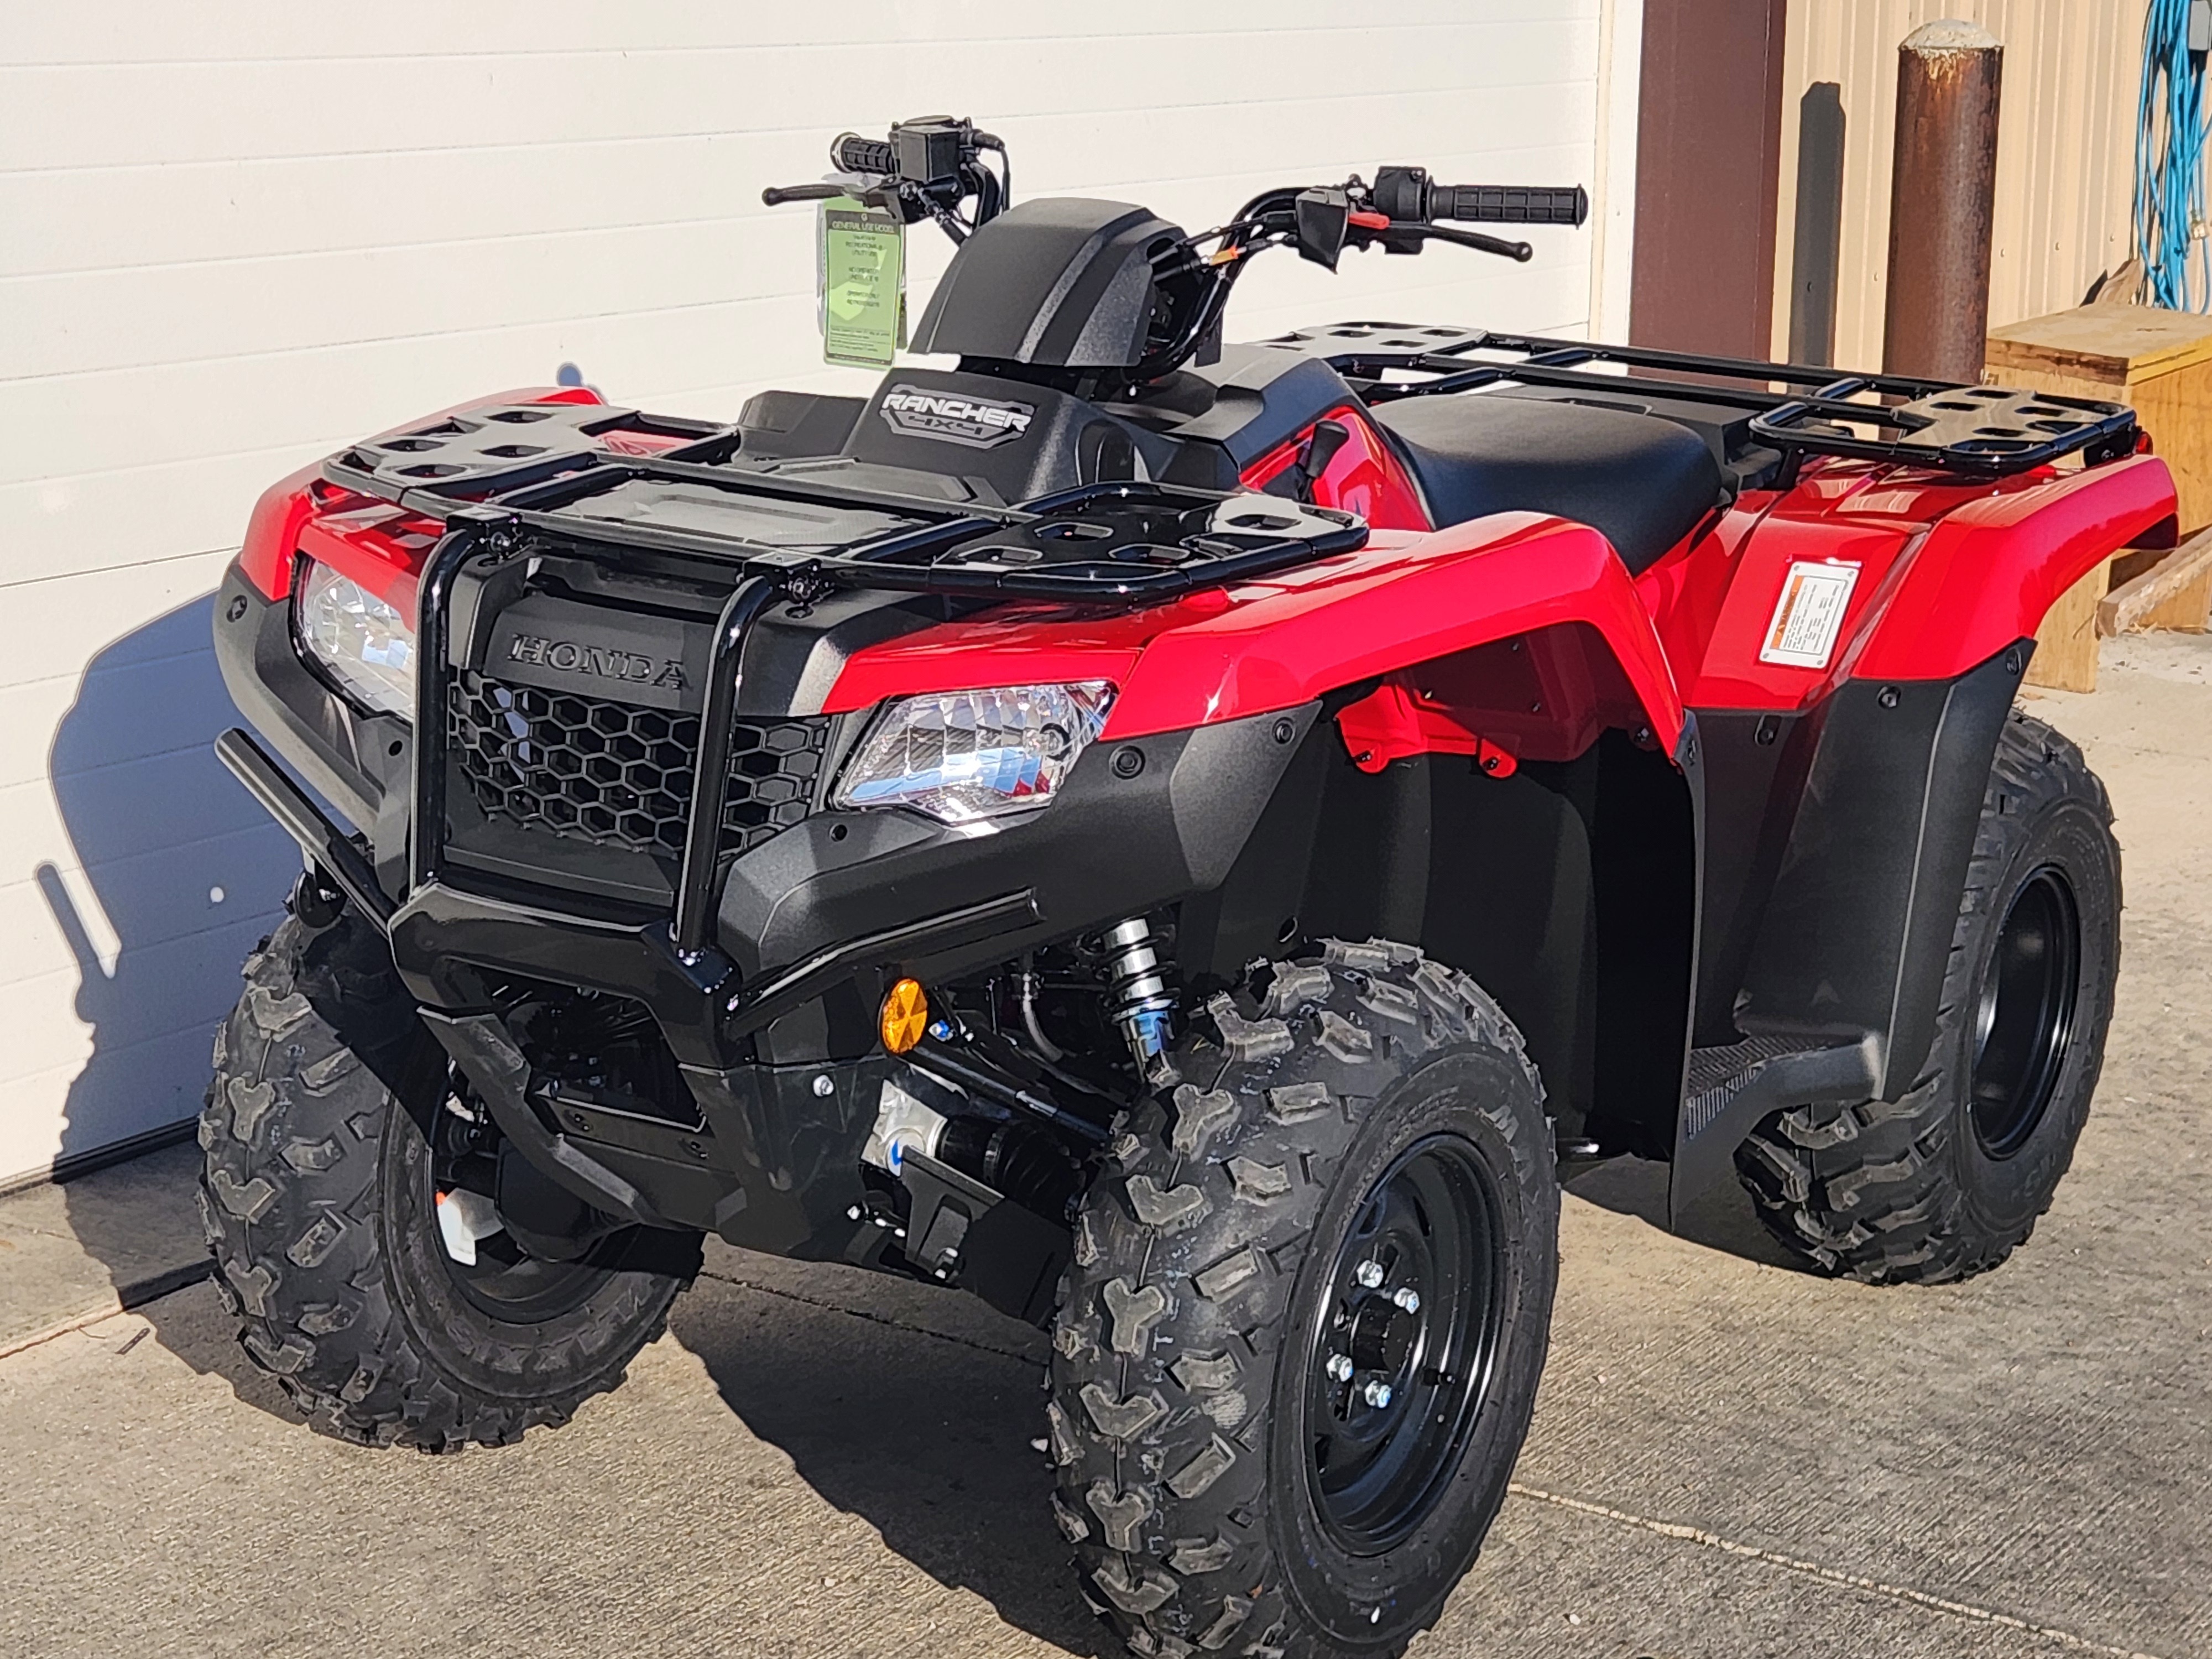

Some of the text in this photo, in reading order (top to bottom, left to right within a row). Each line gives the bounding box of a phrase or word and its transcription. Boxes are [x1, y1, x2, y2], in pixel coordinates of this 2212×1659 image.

[832, 221, 860, 231] GENERAL
[874, 223, 894, 233] MODEL
[882, 394, 1031, 432] RANCHER
[507, 633, 693, 691] HONDA
